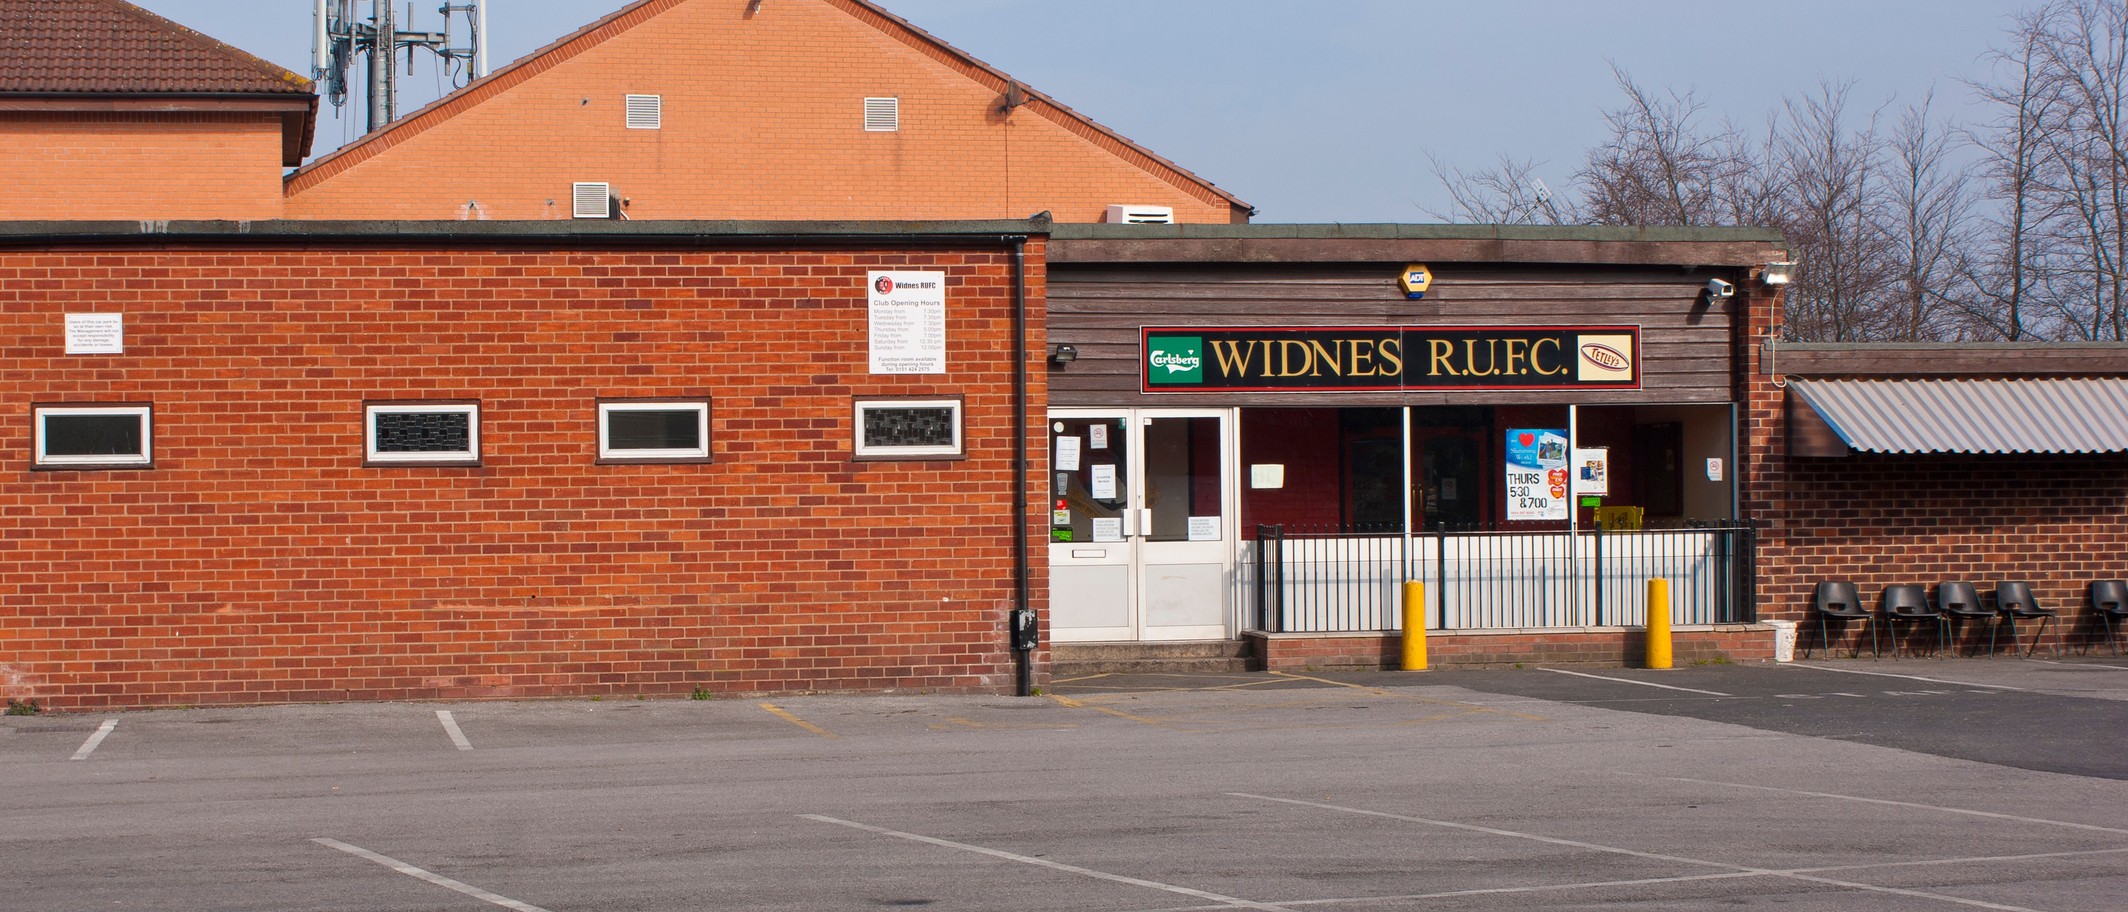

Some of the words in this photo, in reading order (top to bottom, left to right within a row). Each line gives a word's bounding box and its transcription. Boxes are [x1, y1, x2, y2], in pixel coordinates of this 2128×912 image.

[1410, 274, 1424, 282] ADT
[1150, 350, 1200, 368] Carlsberg
[1209, 338, 1402, 378] WIDNES
[1426, 338, 1568, 376] R.U.F.C.
[1591, 348, 1620, 366] TETLEY'S
[1508, 473, 1540, 484] THURS
